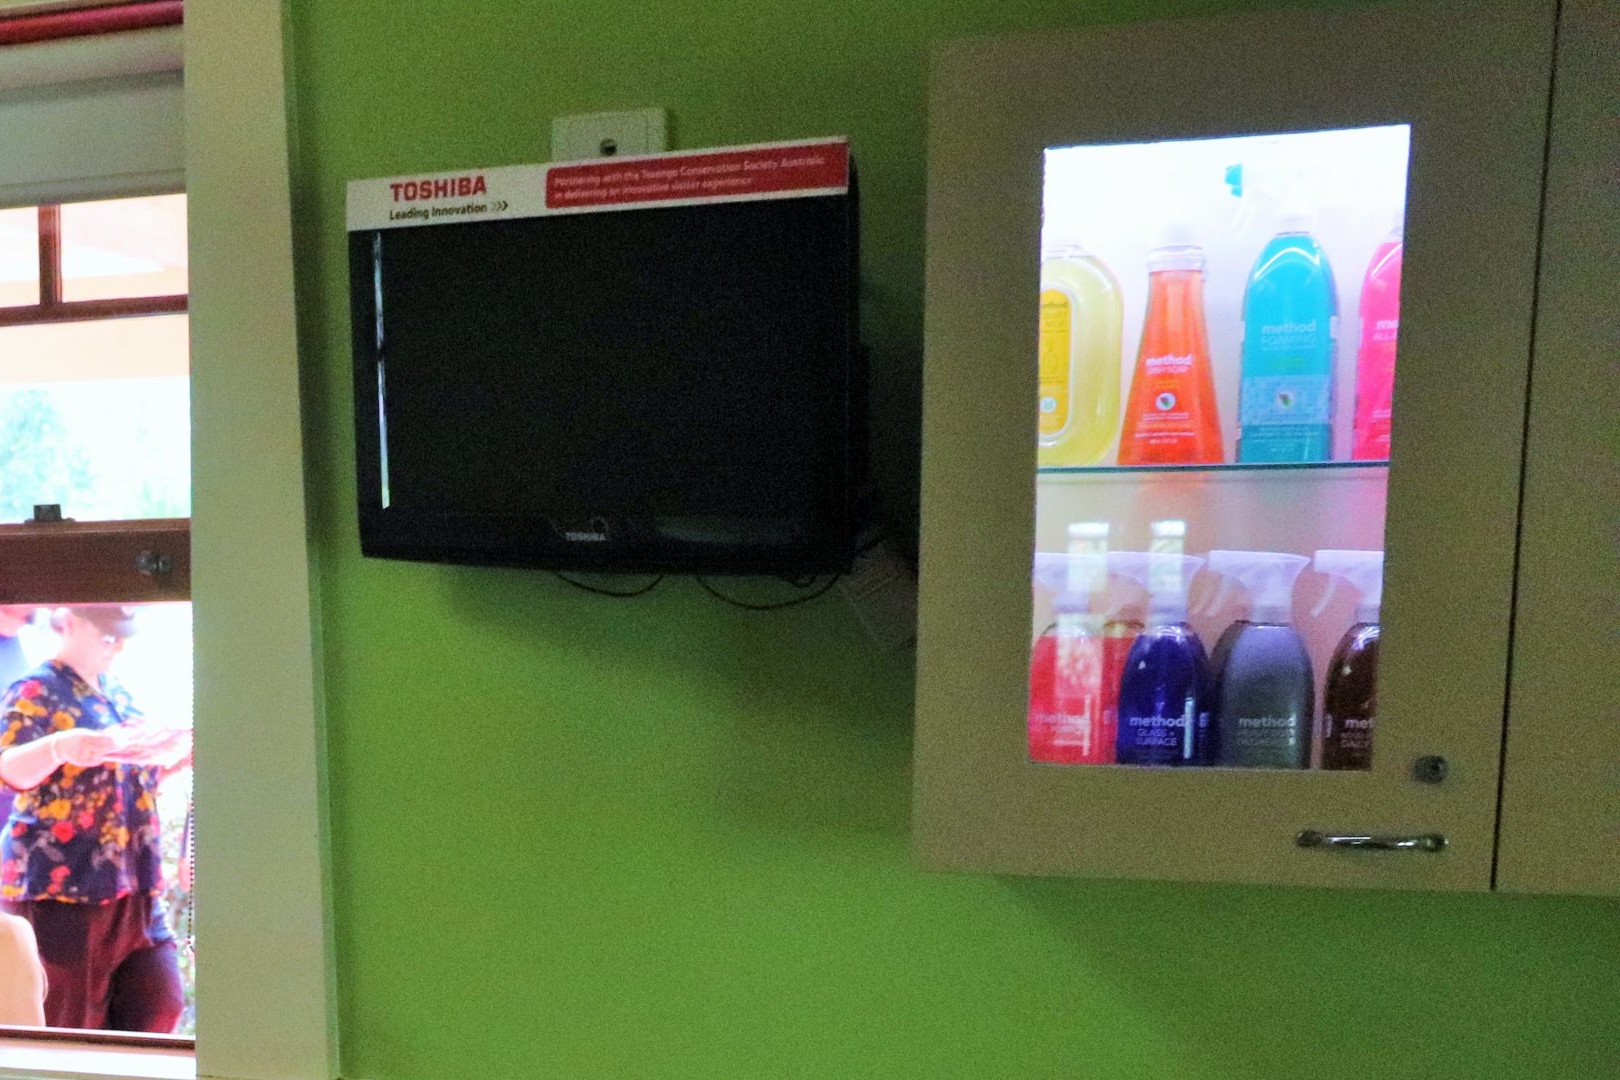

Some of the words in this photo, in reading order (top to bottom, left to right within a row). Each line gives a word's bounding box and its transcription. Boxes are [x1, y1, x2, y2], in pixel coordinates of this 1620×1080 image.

[390, 176, 487, 202] TOSHIBA
[390, 206, 429, 220] Leading
[432, 202, 487, 217] Innovation
[1262, 320, 1317, 334] method
[1146, 354, 1194, 367] method
[1129, 714, 1186, 727] method
[1238, 714, 1296, 728] method
